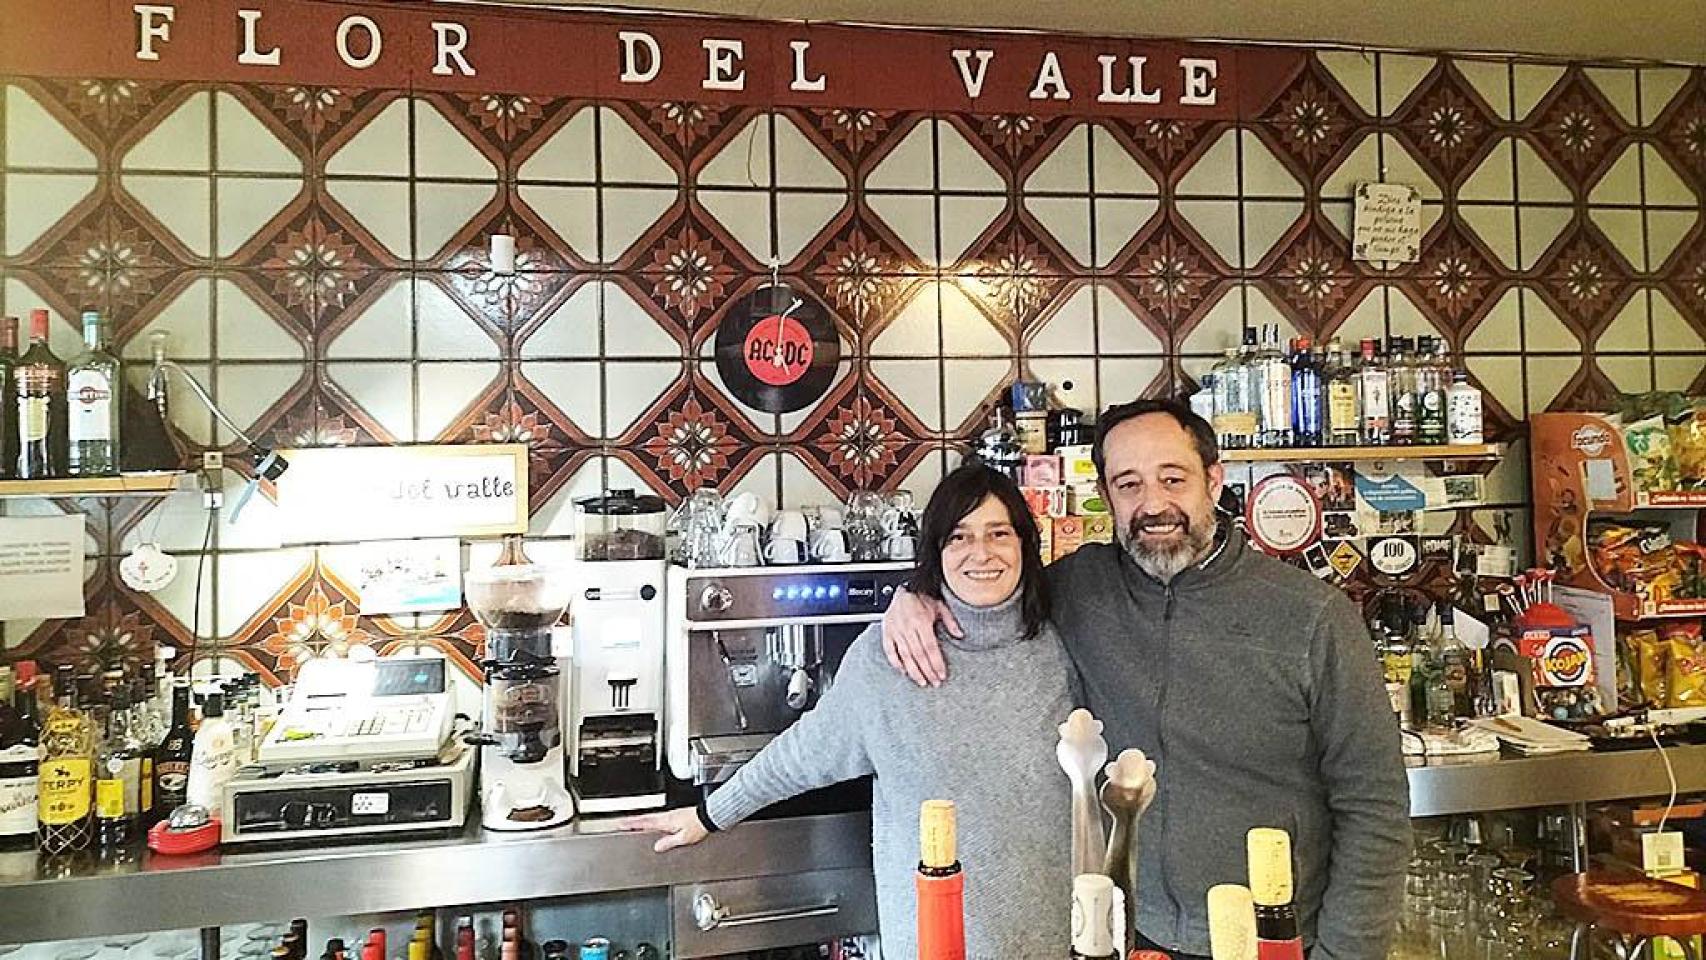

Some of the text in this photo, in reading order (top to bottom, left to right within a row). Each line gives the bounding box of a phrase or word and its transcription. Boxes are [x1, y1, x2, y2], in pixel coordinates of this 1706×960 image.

[133, 4, 1218, 105] FLOR DEL VALLE
[443, 475, 514, 499] valle
[1383, 541, 1405, 558] 100
[1544, 650, 1587, 673] KOJAK
